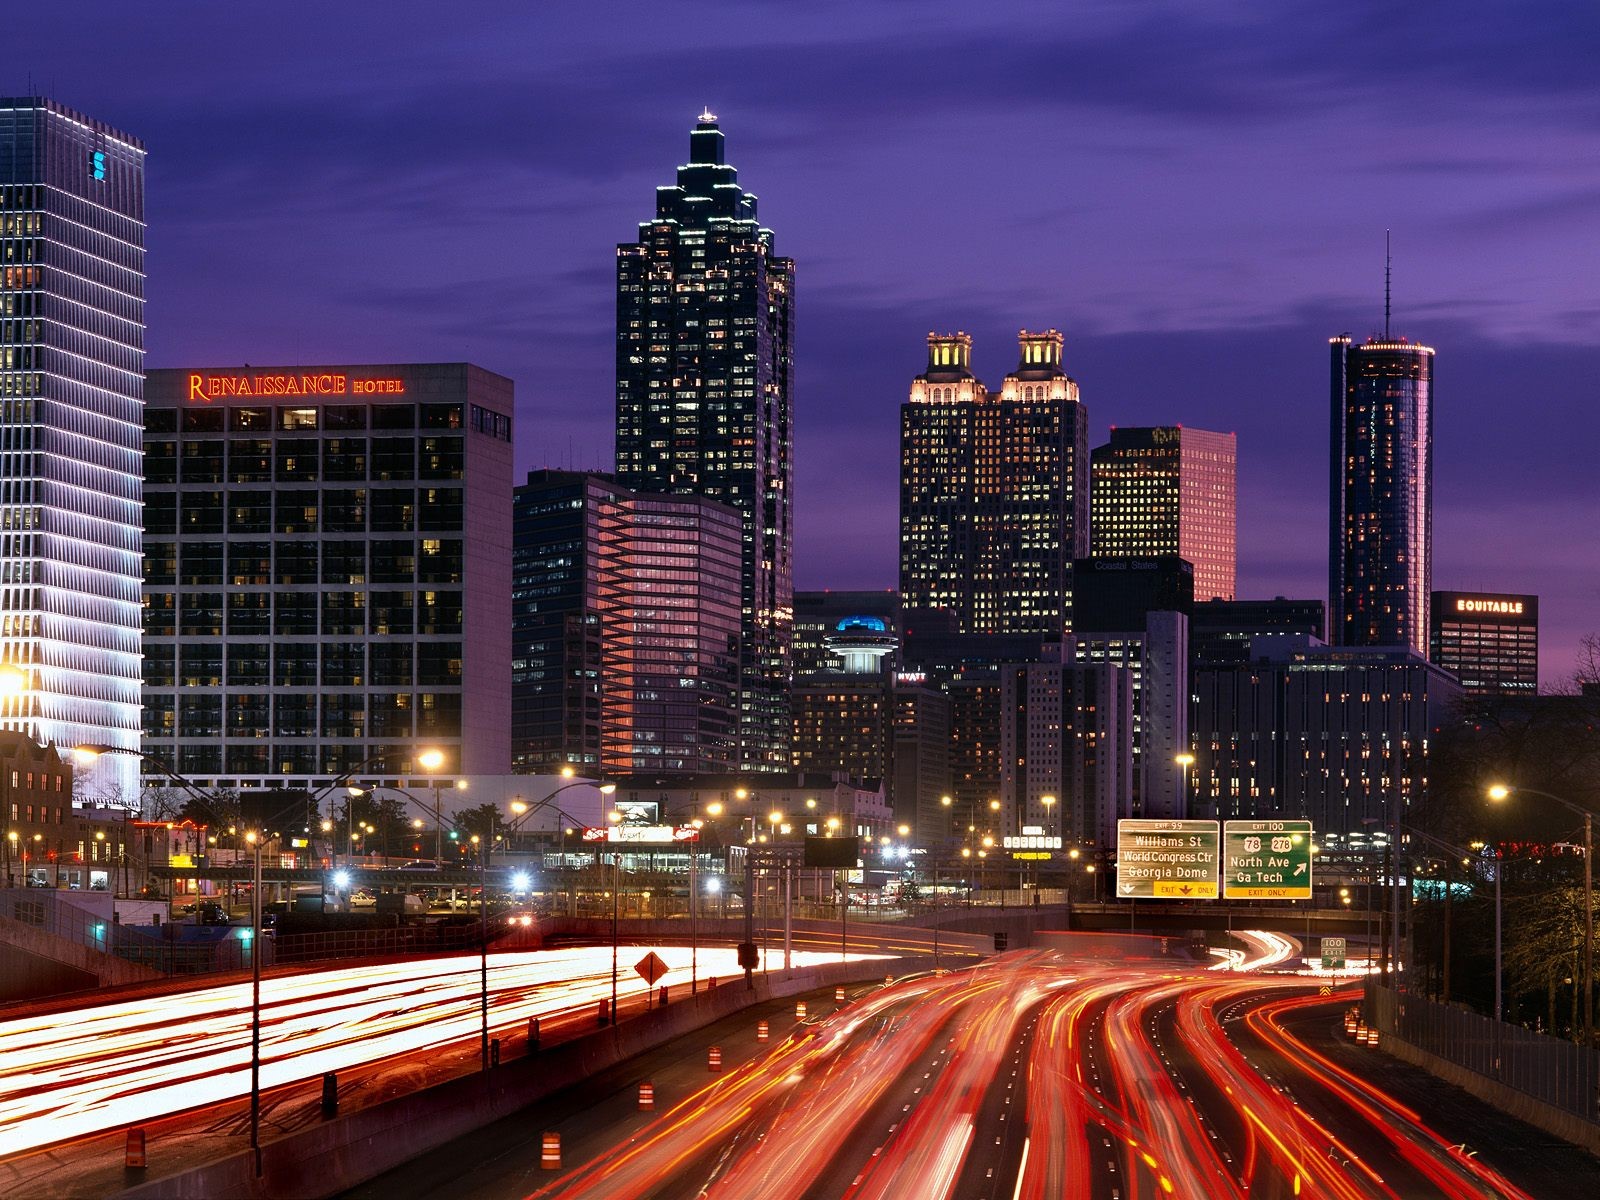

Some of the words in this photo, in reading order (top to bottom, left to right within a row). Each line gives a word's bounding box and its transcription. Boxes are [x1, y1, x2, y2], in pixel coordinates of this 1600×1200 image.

[190, 375, 345, 400] RENAISSANCE
[352, 379, 404, 393] HOTEL
[1094, 561, 1127, 570] Coastal
[1131, 561, 1158, 570] States
[1457, 600, 1523, 613] EQUITABLE
[897, 672, 926, 681] HYATT
[1171, 822, 1183, 830] 99
[1268, 822, 1284, 831] 100
[1135, 836, 1184, 847] Williams
[1189, 836, 1202, 847] St
[1247, 839, 1260, 849] 78
[1273, 839, 1290, 849] 278
[1123, 851, 1150, 862] World
[1151, 851, 1196, 865] Congress
[1197, 852, 1213, 863] Ctr
[1230, 857, 1263, 867] North
[1268, 857, 1290, 867] Ave
[1128, 866, 1172, 880] Georgia
[1176, 867, 1208, 878] Dome
[1237, 872, 1251, 883] Ga
[1256, 872, 1283, 883] Tech
